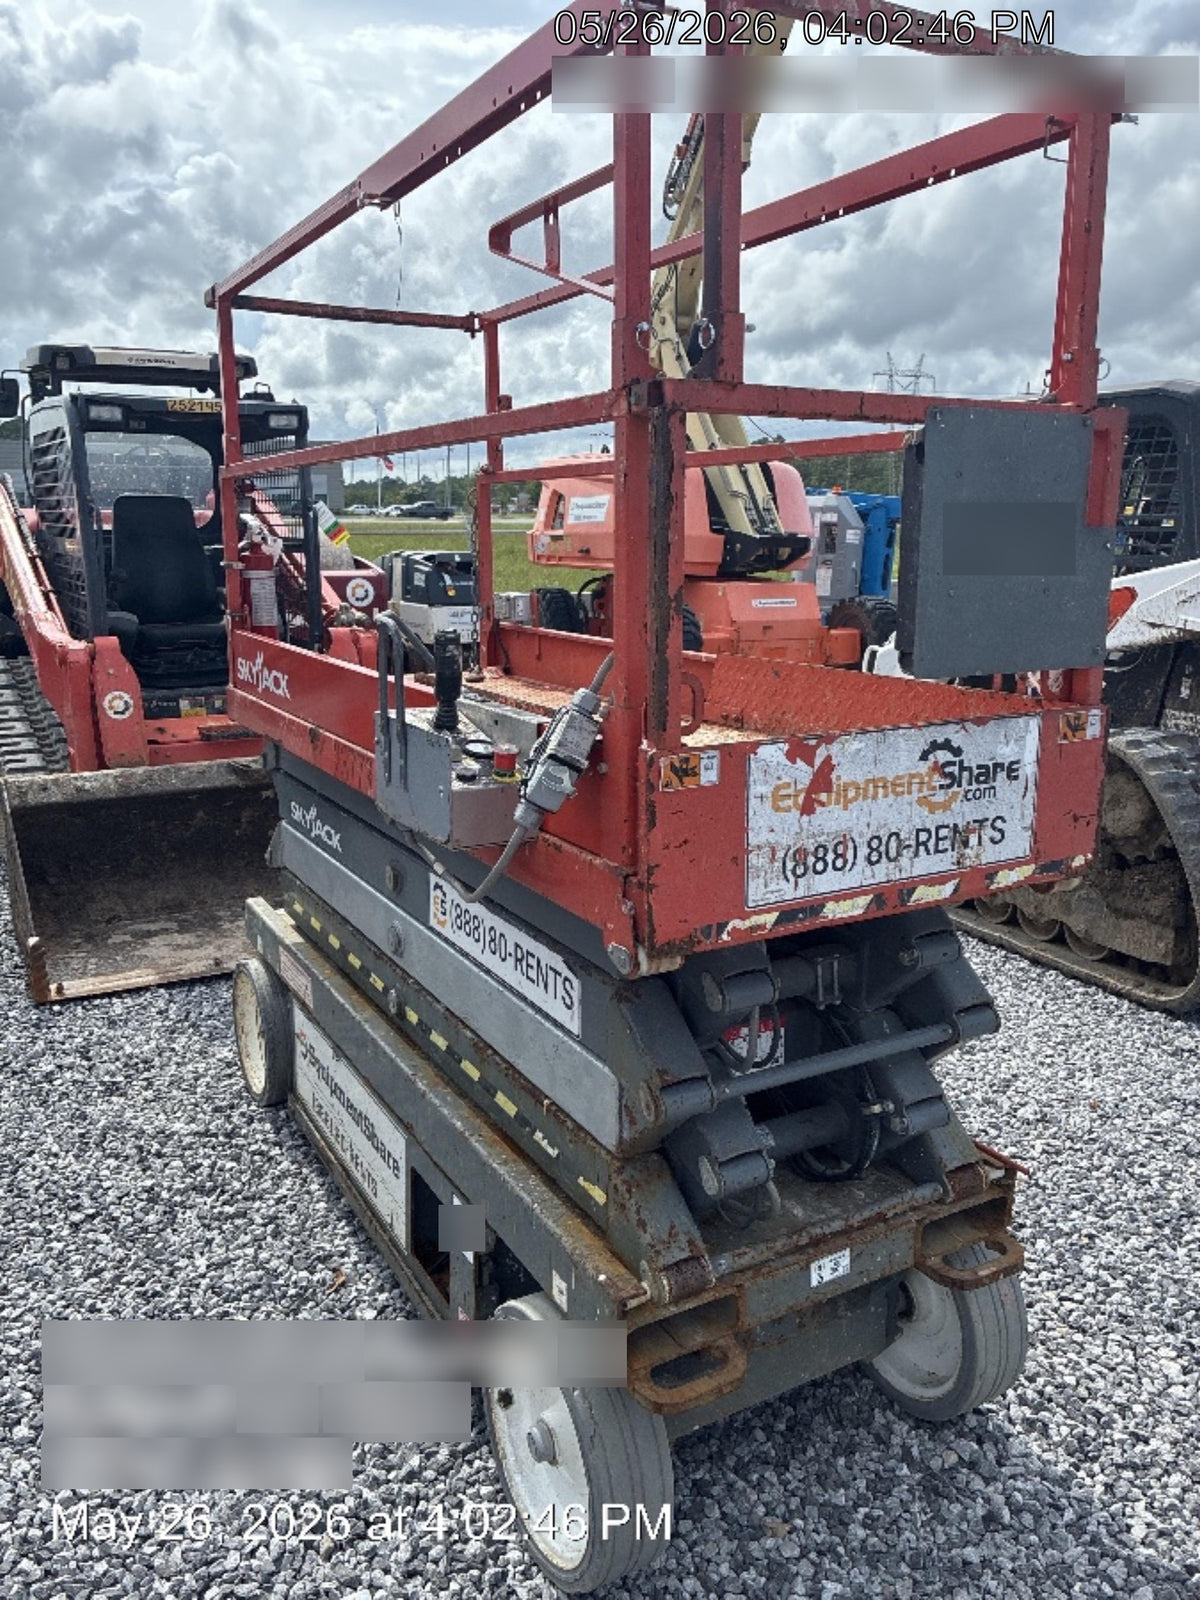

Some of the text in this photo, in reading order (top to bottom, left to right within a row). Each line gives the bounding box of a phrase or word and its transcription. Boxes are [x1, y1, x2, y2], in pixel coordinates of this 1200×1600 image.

[237, 651, 291, 701] SKYJACK
[291, 801, 343, 853] SKYJACK
[782, 815, 1007, 884] (888) 80-RENTS
